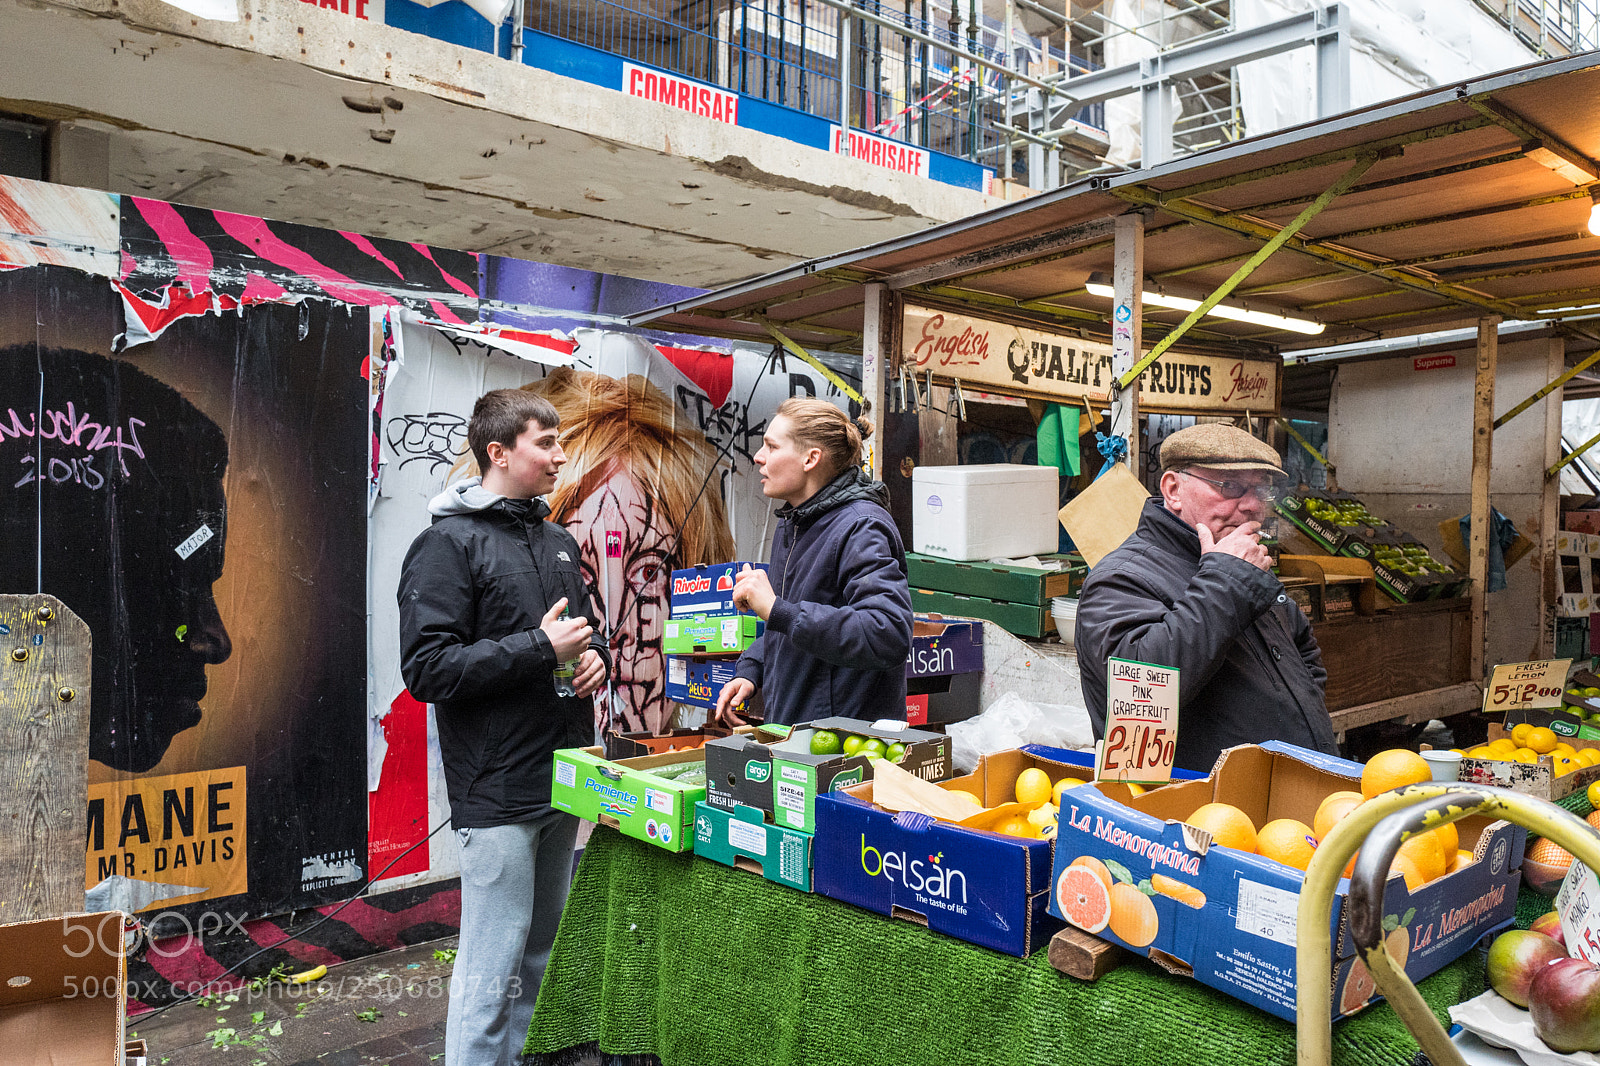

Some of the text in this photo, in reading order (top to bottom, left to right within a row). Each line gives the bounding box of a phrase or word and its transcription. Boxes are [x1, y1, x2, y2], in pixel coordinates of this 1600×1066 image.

[630, 68, 738, 126] COMBISAF
[914, 314, 989, 367] English
[1416, 357, 1454, 368] Supreme
[1222, 362, 1268, 402] Foreign
[180, 528, 209, 556] MAJOR
[1305, 517, 1337, 545] FRESH LIMES
[673, 574, 711, 595] Rivoira
[1374, 565, 1408, 595] FRESH LIMES
[907, 646, 954, 675] lsan
[1515, 662, 1549, 672] FRESH
[1112, 663, 1171, 684] LARGE SWEET
[1508, 671, 1546, 680] LEMON
[1132, 685, 1153, 700] PINK
[1112, 699, 1170, 720] GRAPEFRUIT
[1554, 722, 1573, 734] argo
[749, 765, 767, 778] argo
[585, 777, 638, 804] Poniente
[709, 794, 726, 805] FRESH
[1068, 804, 1091, 833] La
[1092, 815, 1201, 876] Menorquina
[915, 893, 967, 915] The taste of life
[1569, 891, 1590, 933] MANGO
[1412, 884, 1506, 952] La Menorquina
[1260, 927, 1274, 937] 40
[1233, 948, 1255, 963] Emilio
[1256, 958, 1281, 975] Sastre,
